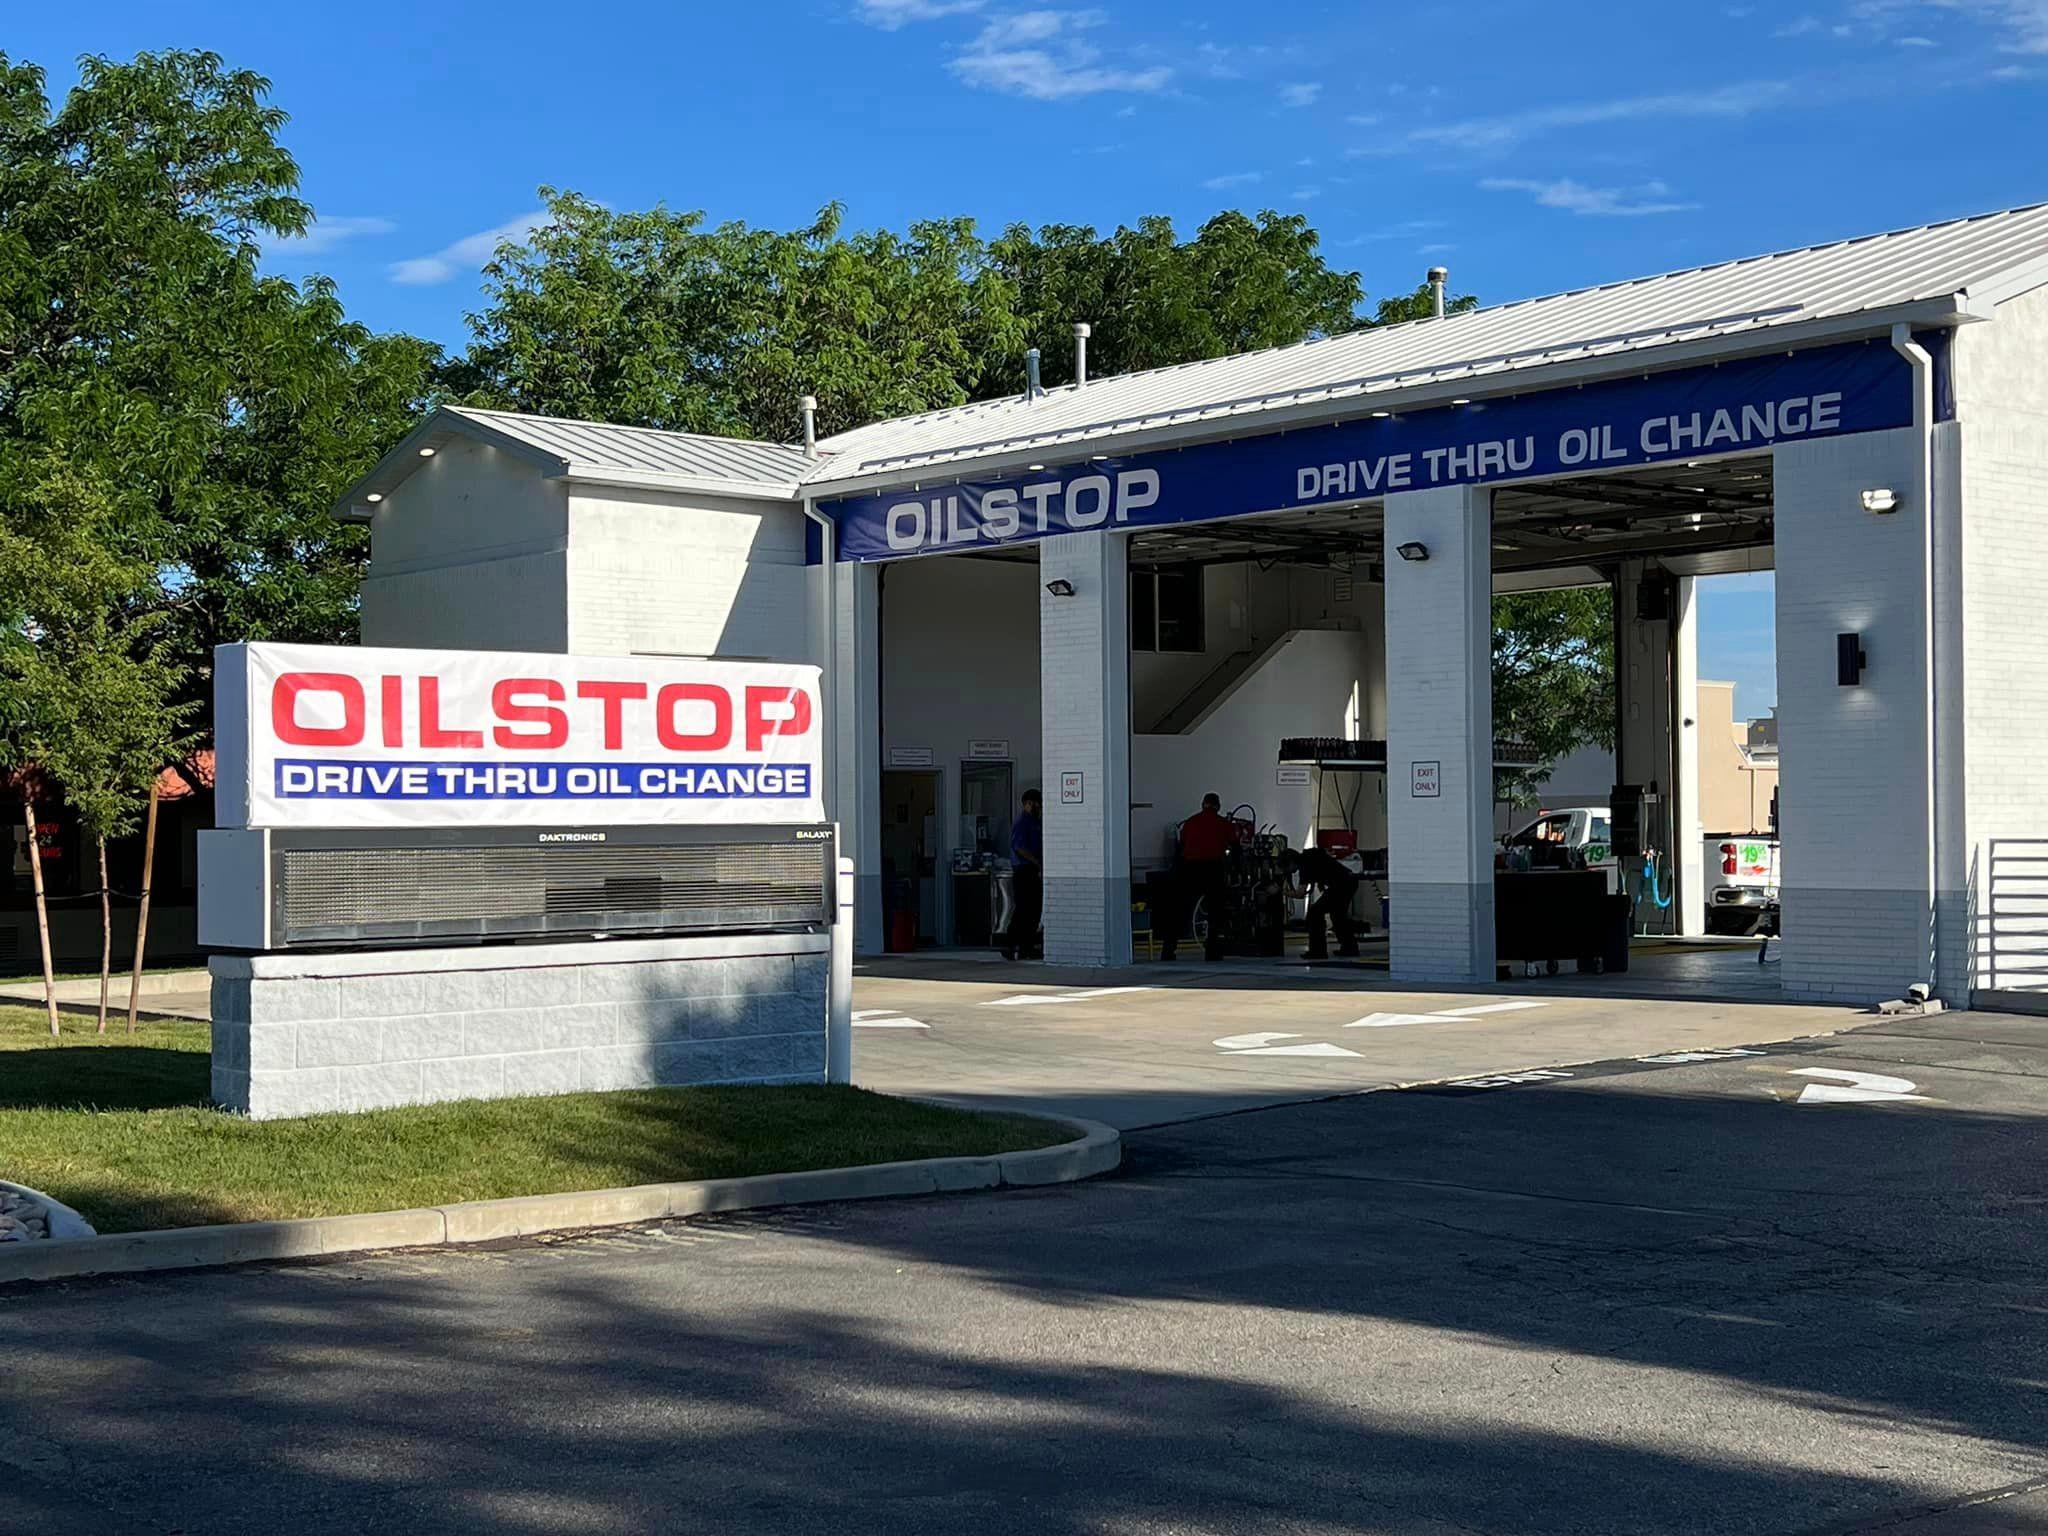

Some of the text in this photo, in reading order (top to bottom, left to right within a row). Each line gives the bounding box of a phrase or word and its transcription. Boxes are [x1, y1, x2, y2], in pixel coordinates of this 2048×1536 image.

[1297, 392, 1842, 500] DRIVE THRU OIL CHANGE
[886, 468, 1160, 550] OILSTOP
[271, 672, 811, 752] OILSTOP
[282, 765, 806, 794] DRIVE THRU OIL CHANGE
[1415, 782, 1436, 791] ONLY
[1417, 768, 1435, 777] EXIT
[539, 833, 606, 842] DAKTRONICS
